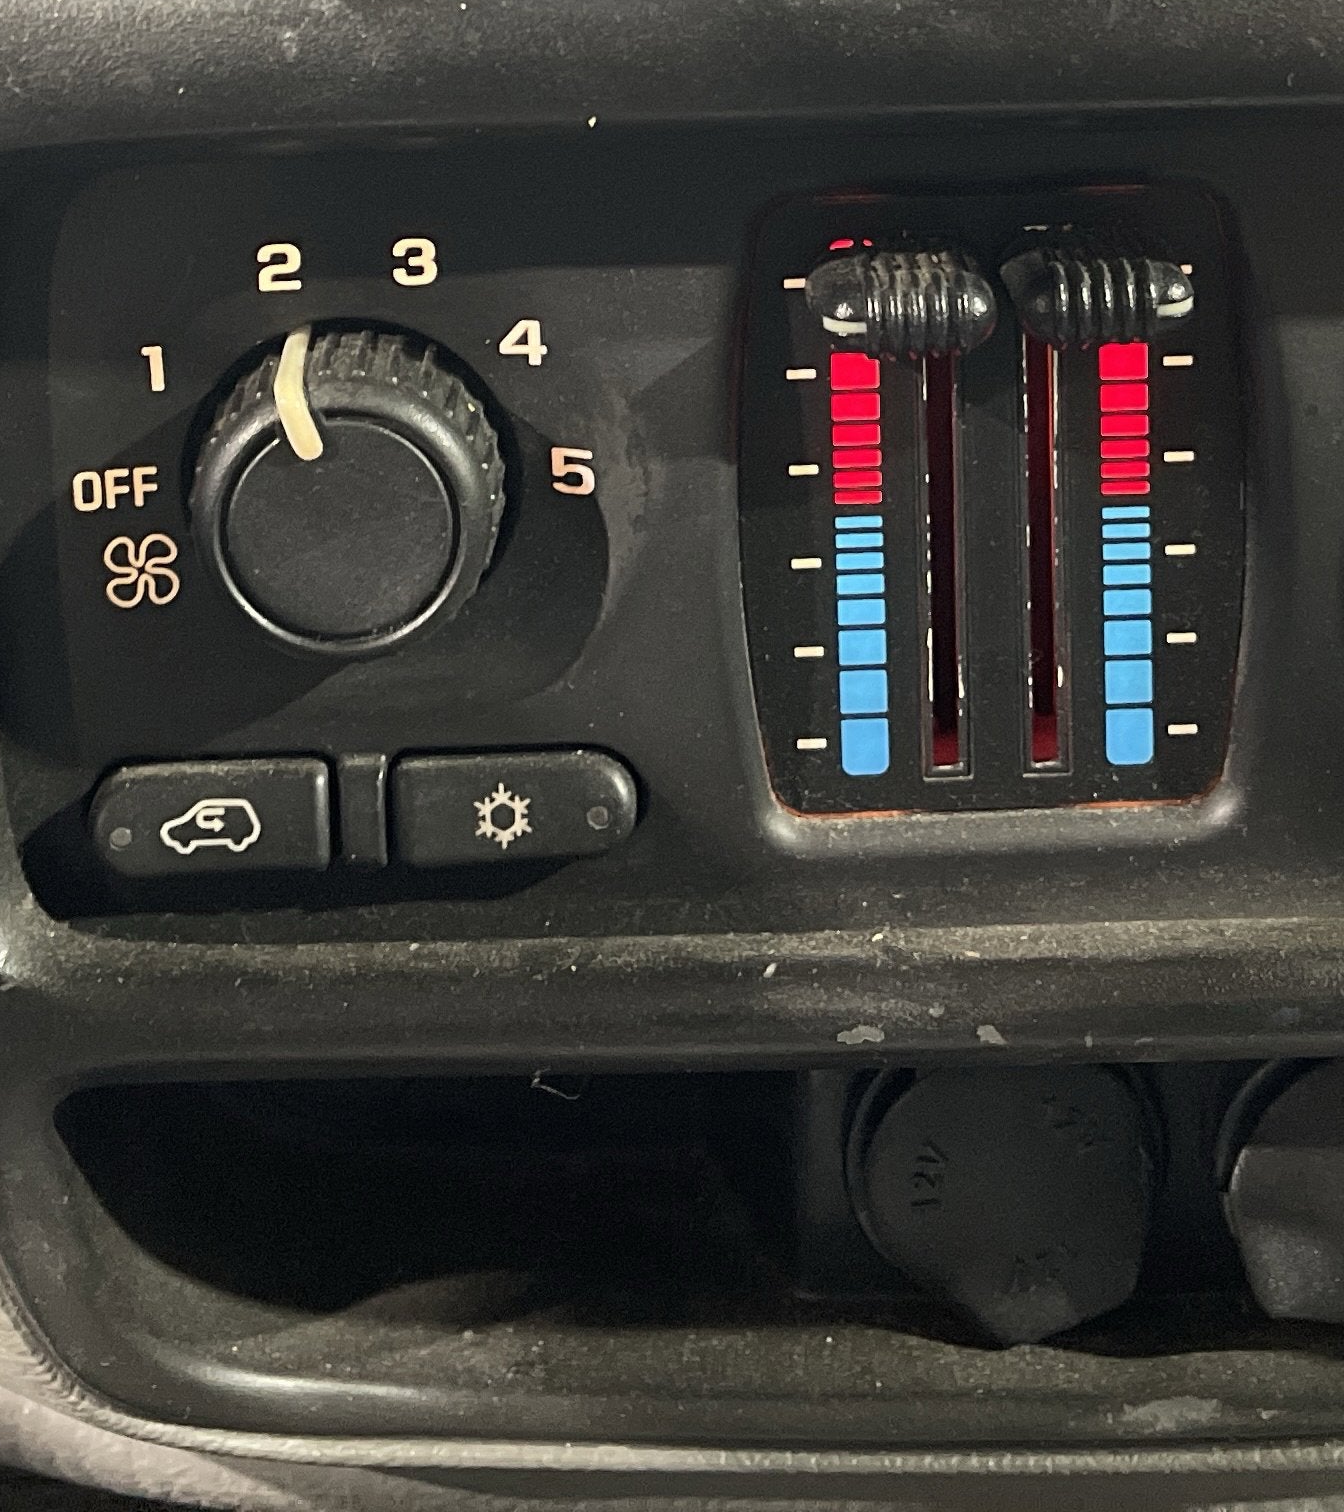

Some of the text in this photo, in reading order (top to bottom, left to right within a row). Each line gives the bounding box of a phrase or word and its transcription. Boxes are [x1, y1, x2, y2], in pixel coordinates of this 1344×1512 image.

[257, 244, 302, 292] 2
[392, 238, 438, 287] 3
[498, 319, 547, 366] 4
[140, 345, 165, 392] 1
[72, 466, 158, 512] OFF
[551, 447, 595, 495] 5
